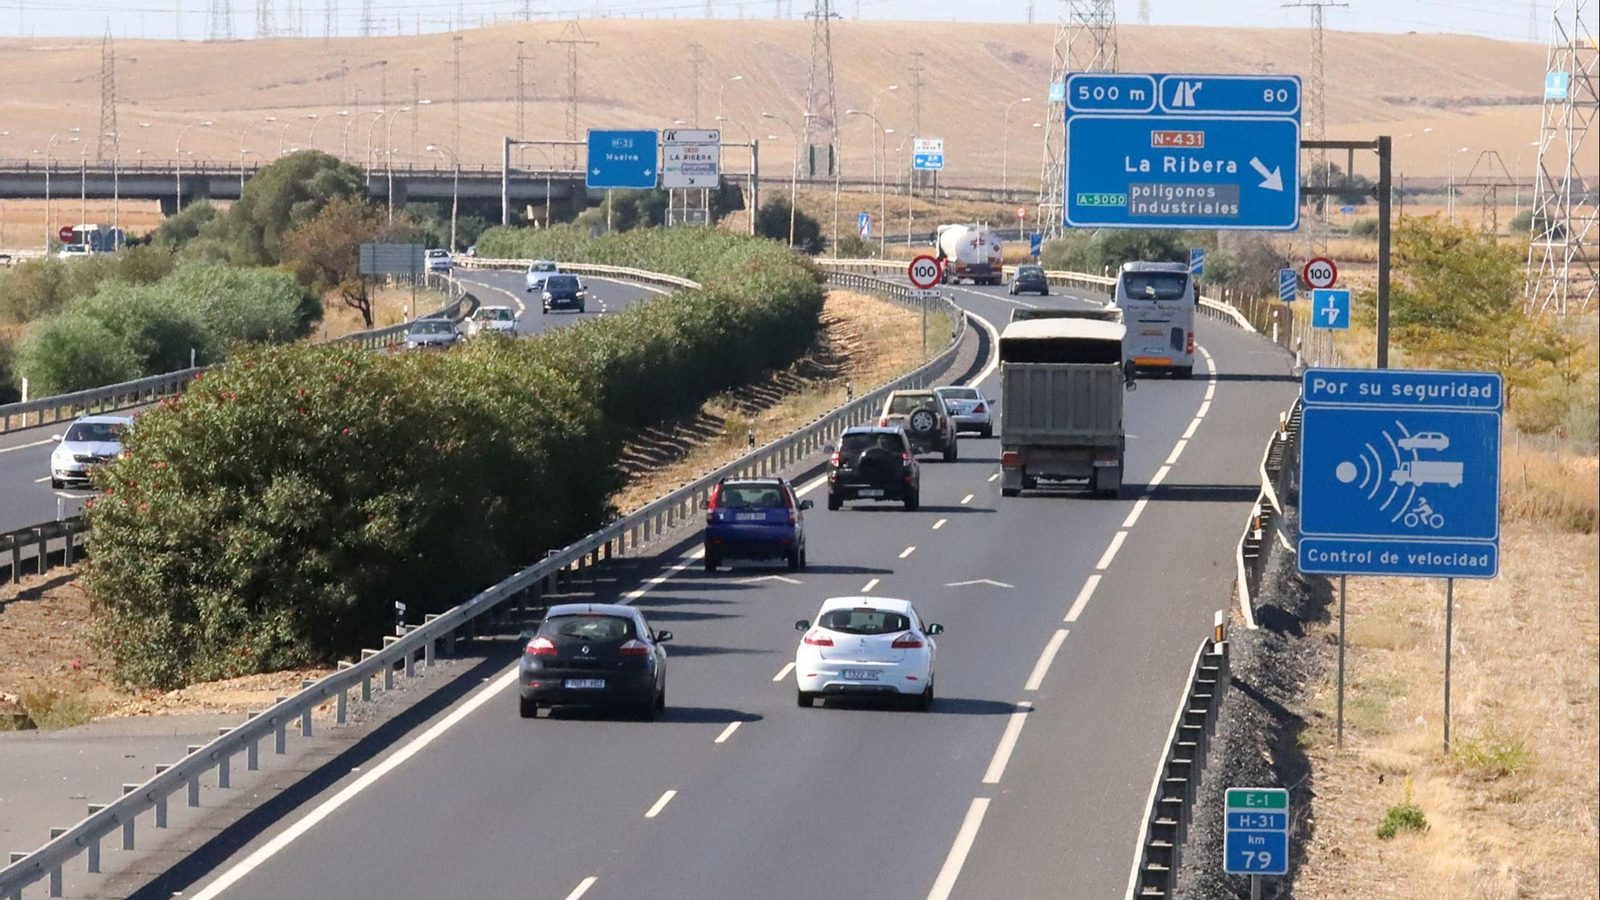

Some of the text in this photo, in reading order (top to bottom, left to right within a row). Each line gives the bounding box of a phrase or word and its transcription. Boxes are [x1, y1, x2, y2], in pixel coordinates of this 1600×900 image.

[1079, 86, 1146, 101] 500 m
[1263, 89, 1289, 103] 80
[1154, 133, 1203, 146] N-431
[606, 153, 639, 161] Huelva
[1125, 156, 1238, 174] La Ribera
[1079, 194, 1126, 206] A-5000
[1131, 201, 1239, 215] industriales
[914, 266, 936, 277] 100
[1310, 269, 1331, 279] 100
[1313, 379, 1492, 401] Por su seguridad
[1308, 549, 1488, 567] Control de velocidad
[1246, 794, 1268, 806] E-1
[1239, 815, 1274, 827] H-31
[1248, 835, 1265, 845] km
[1241, 851, 1272, 869] 79
